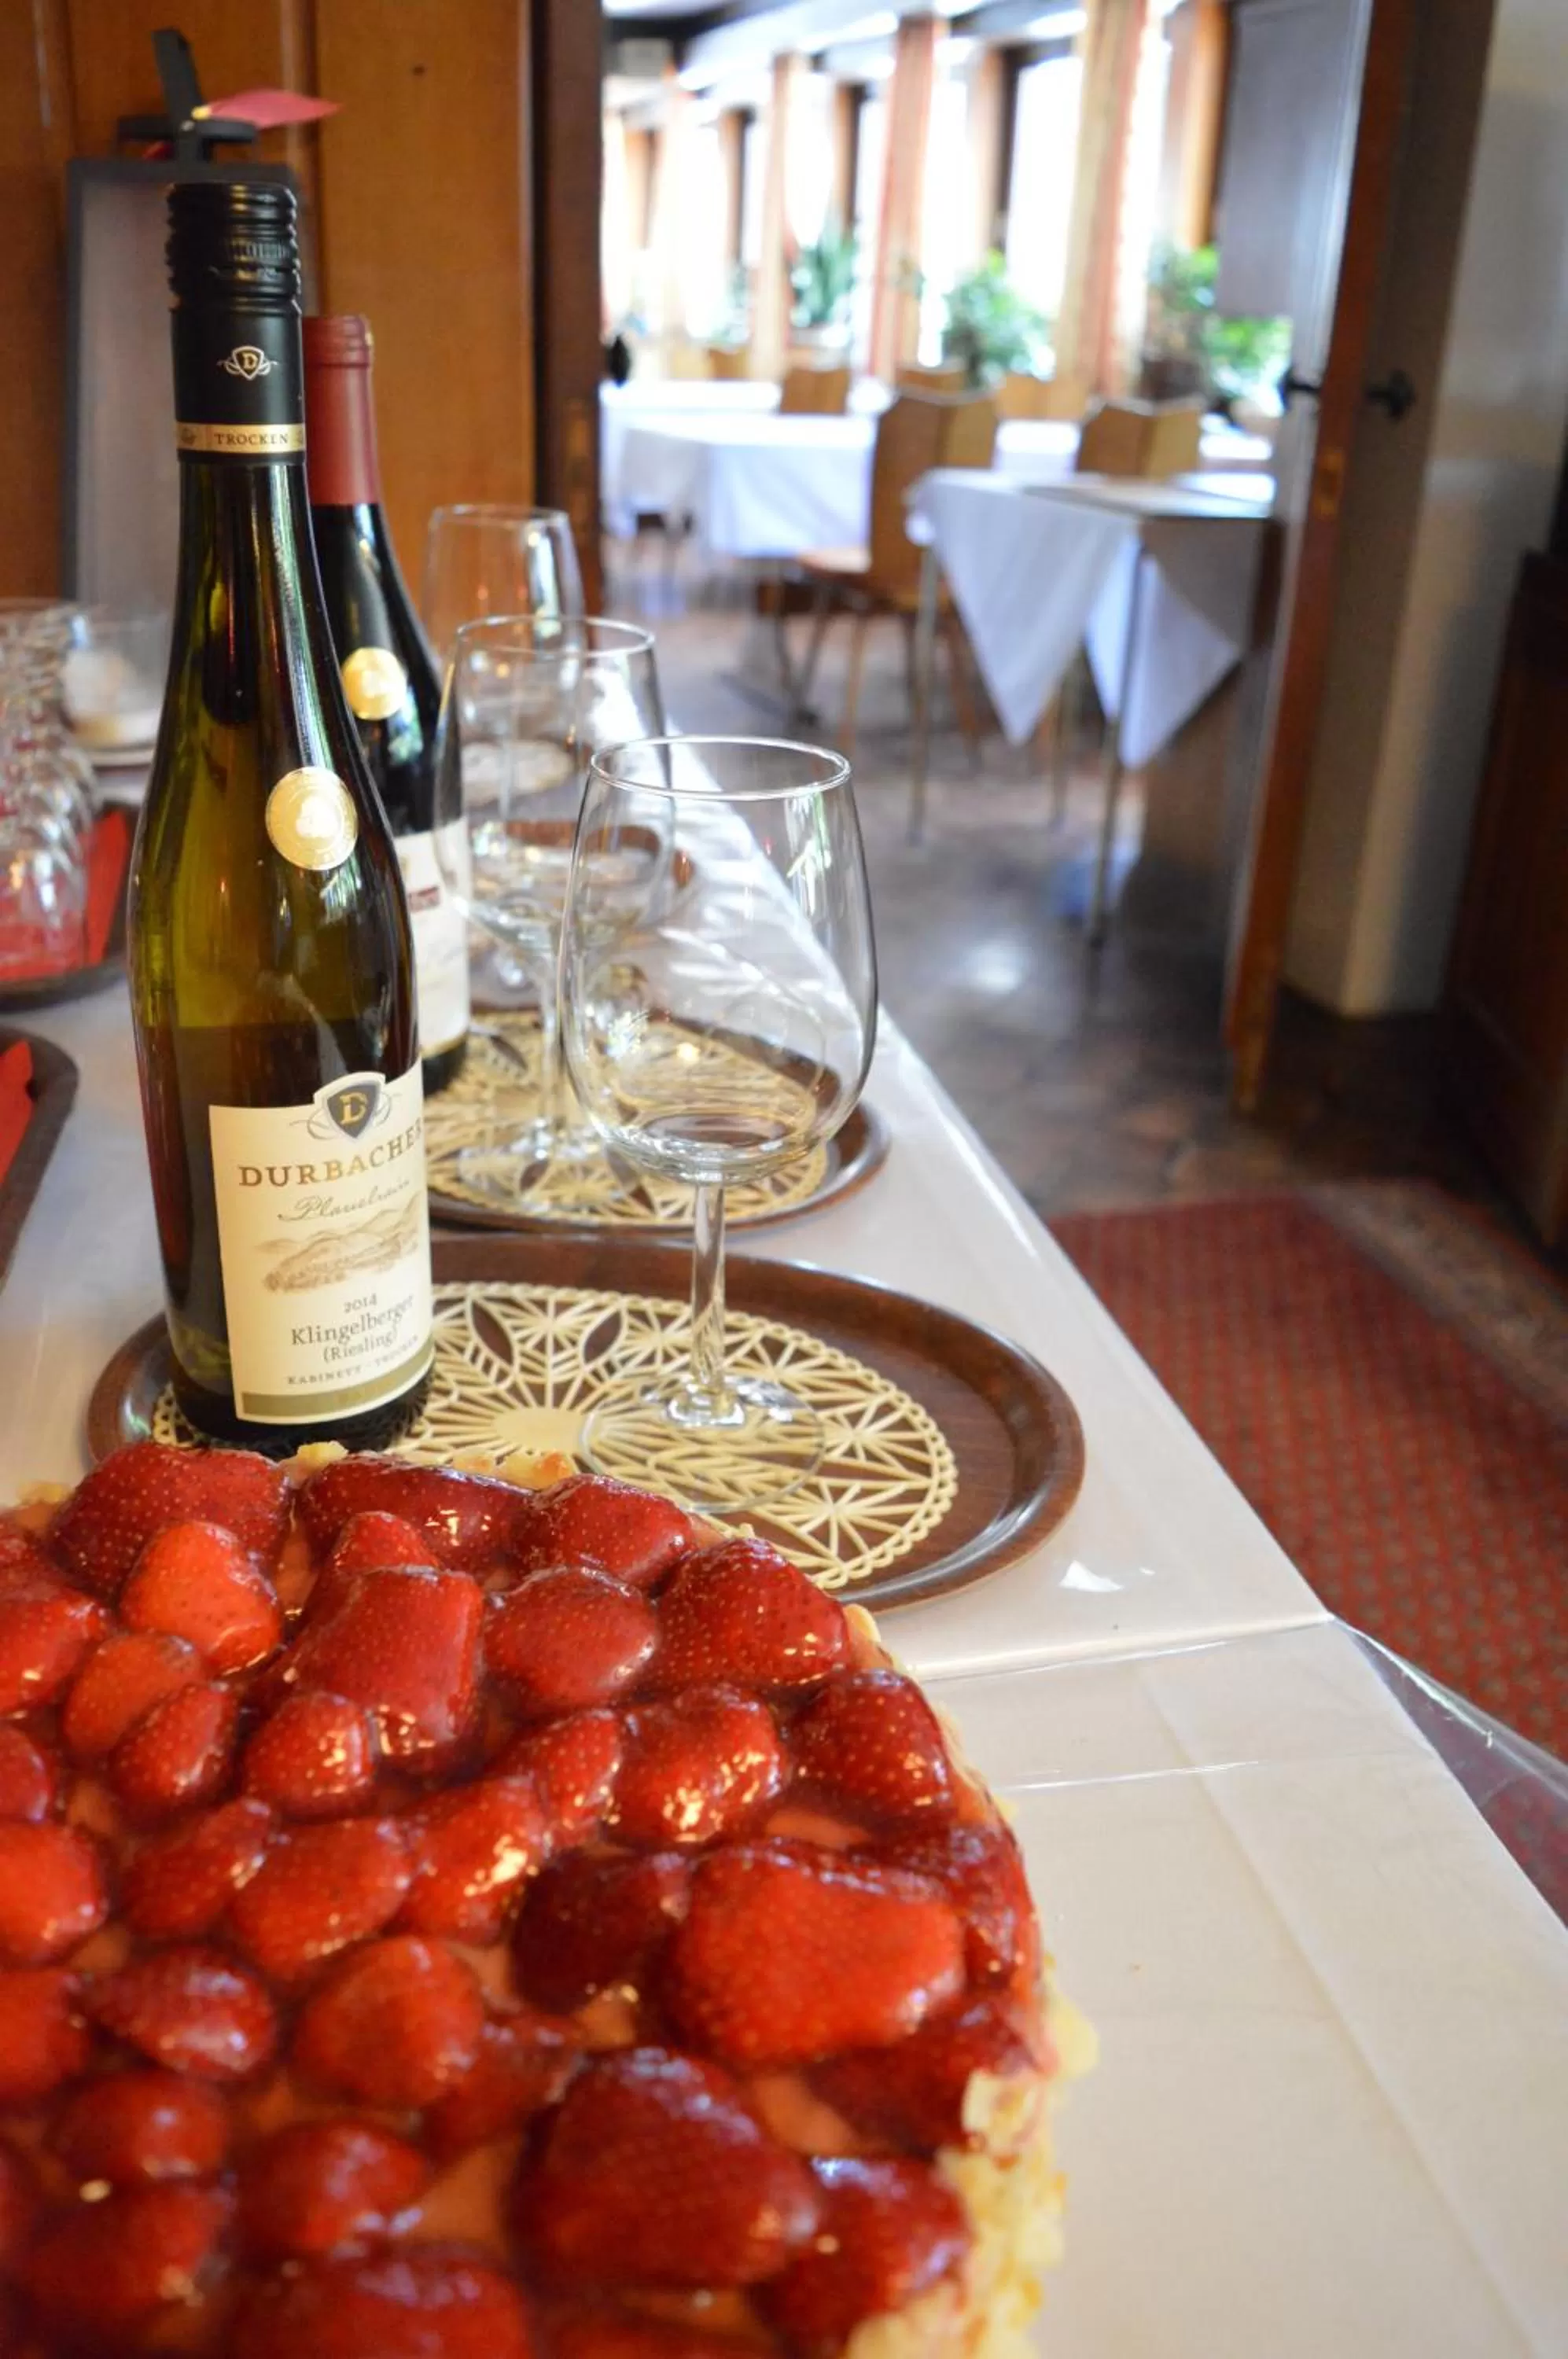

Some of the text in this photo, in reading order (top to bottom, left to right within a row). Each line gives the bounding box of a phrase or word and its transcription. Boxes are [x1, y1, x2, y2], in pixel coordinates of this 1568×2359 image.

[244, 354, 257, 370] D
[214, 433, 288, 445] TROCKEN
[339, 1091, 367, 1125] D
[344, 1293, 377, 1314] 2014
[291, 1294, 414, 1345] Klingelberger
[323, 1323, 397, 1362] (Riesling)
